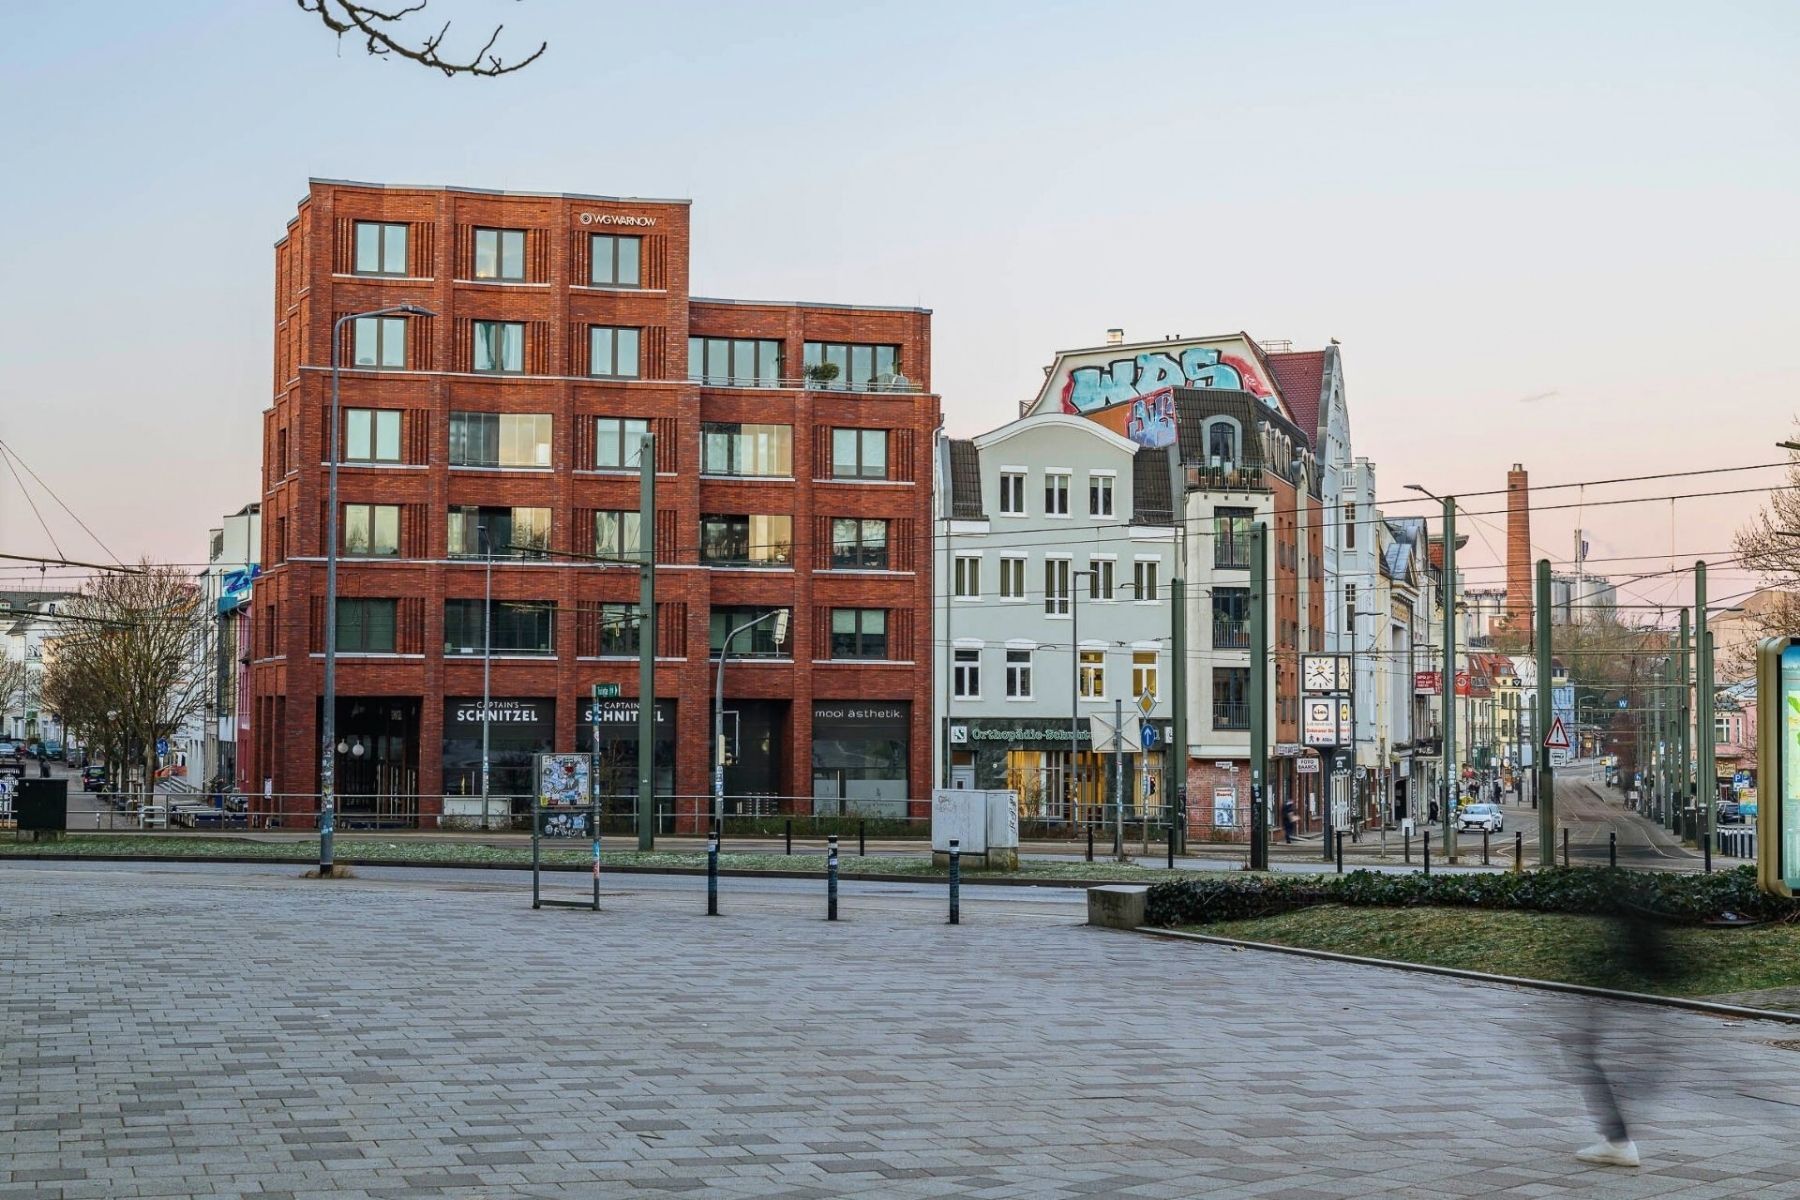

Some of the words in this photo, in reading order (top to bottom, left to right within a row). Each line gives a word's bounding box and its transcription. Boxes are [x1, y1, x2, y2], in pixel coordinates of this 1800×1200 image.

[604, 702, 640, 710] CAPTAIN
[457, 709, 538, 722] SCHNITZEL
[585, 710, 664, 722] SHNITL
[815, 709, 844, 718] mooi
